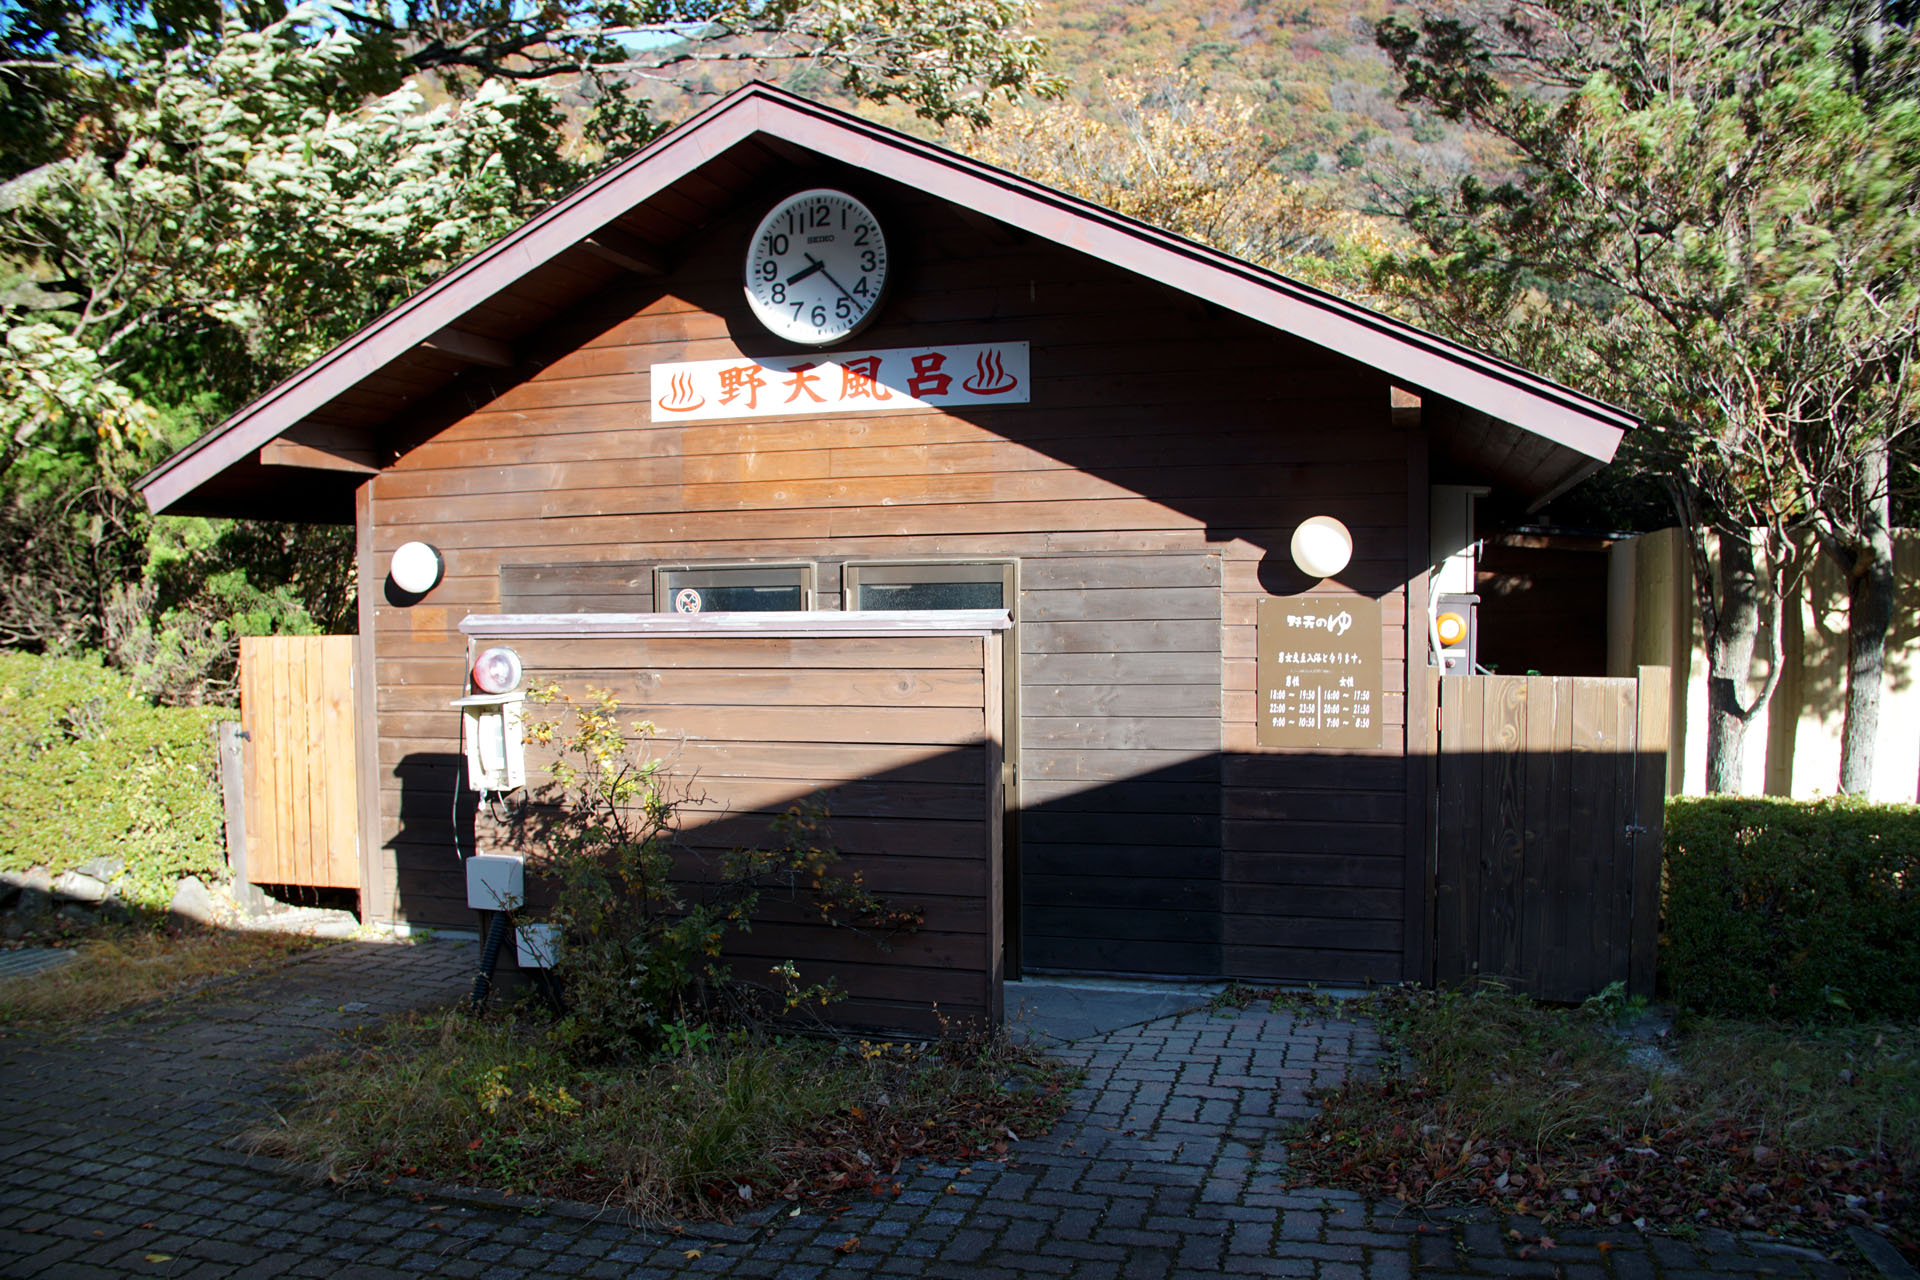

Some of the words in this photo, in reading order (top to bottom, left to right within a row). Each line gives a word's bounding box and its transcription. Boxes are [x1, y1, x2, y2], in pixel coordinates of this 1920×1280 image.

[789, 213, 804, 234] 11
[809, 205, 830, 227] 12
[841, 209, 846, 230] 1
[769, 234, 789, 256] 10
[807, 235, 835, 244] SEIKO
[854, 225, 869, 246] 2
[763, 260, 777, 282] 9
[860, 250, 876, 272] 3
[771, 283, 785, 304] 8
[853, 277, 869, 297] 4
[789, 302, 804, 322] 7
[811, 306, 826, 327] 6
[835, 297, 851, 319] 5
[717, 352, 953, 410] 野天風呂
[1285, 675, 1300, 687] 男性
[1339, 676, 1354, 688] 女性
[1270, 689, 1286, 700] 18:00
[1299, 690, 1315, 700] 19:50
[1324, 690, 1340, 700] 16:00
[1354, 690, 1370, 701] 17:50
[1269, 703, 1286, 714] 22:00
[1299, 703, 1315, 714] 23:50
[1323, 704, 1340, 714] 20:00
[1353, 704, 1370, 714] 21:50
[1272, 717, 1286, 727] 9:00
[1299, 717, 1315, 728] 10:50
[1326, 718, 1340, 728] 7:00
[1355, 718, 1370, 728] 8:50
